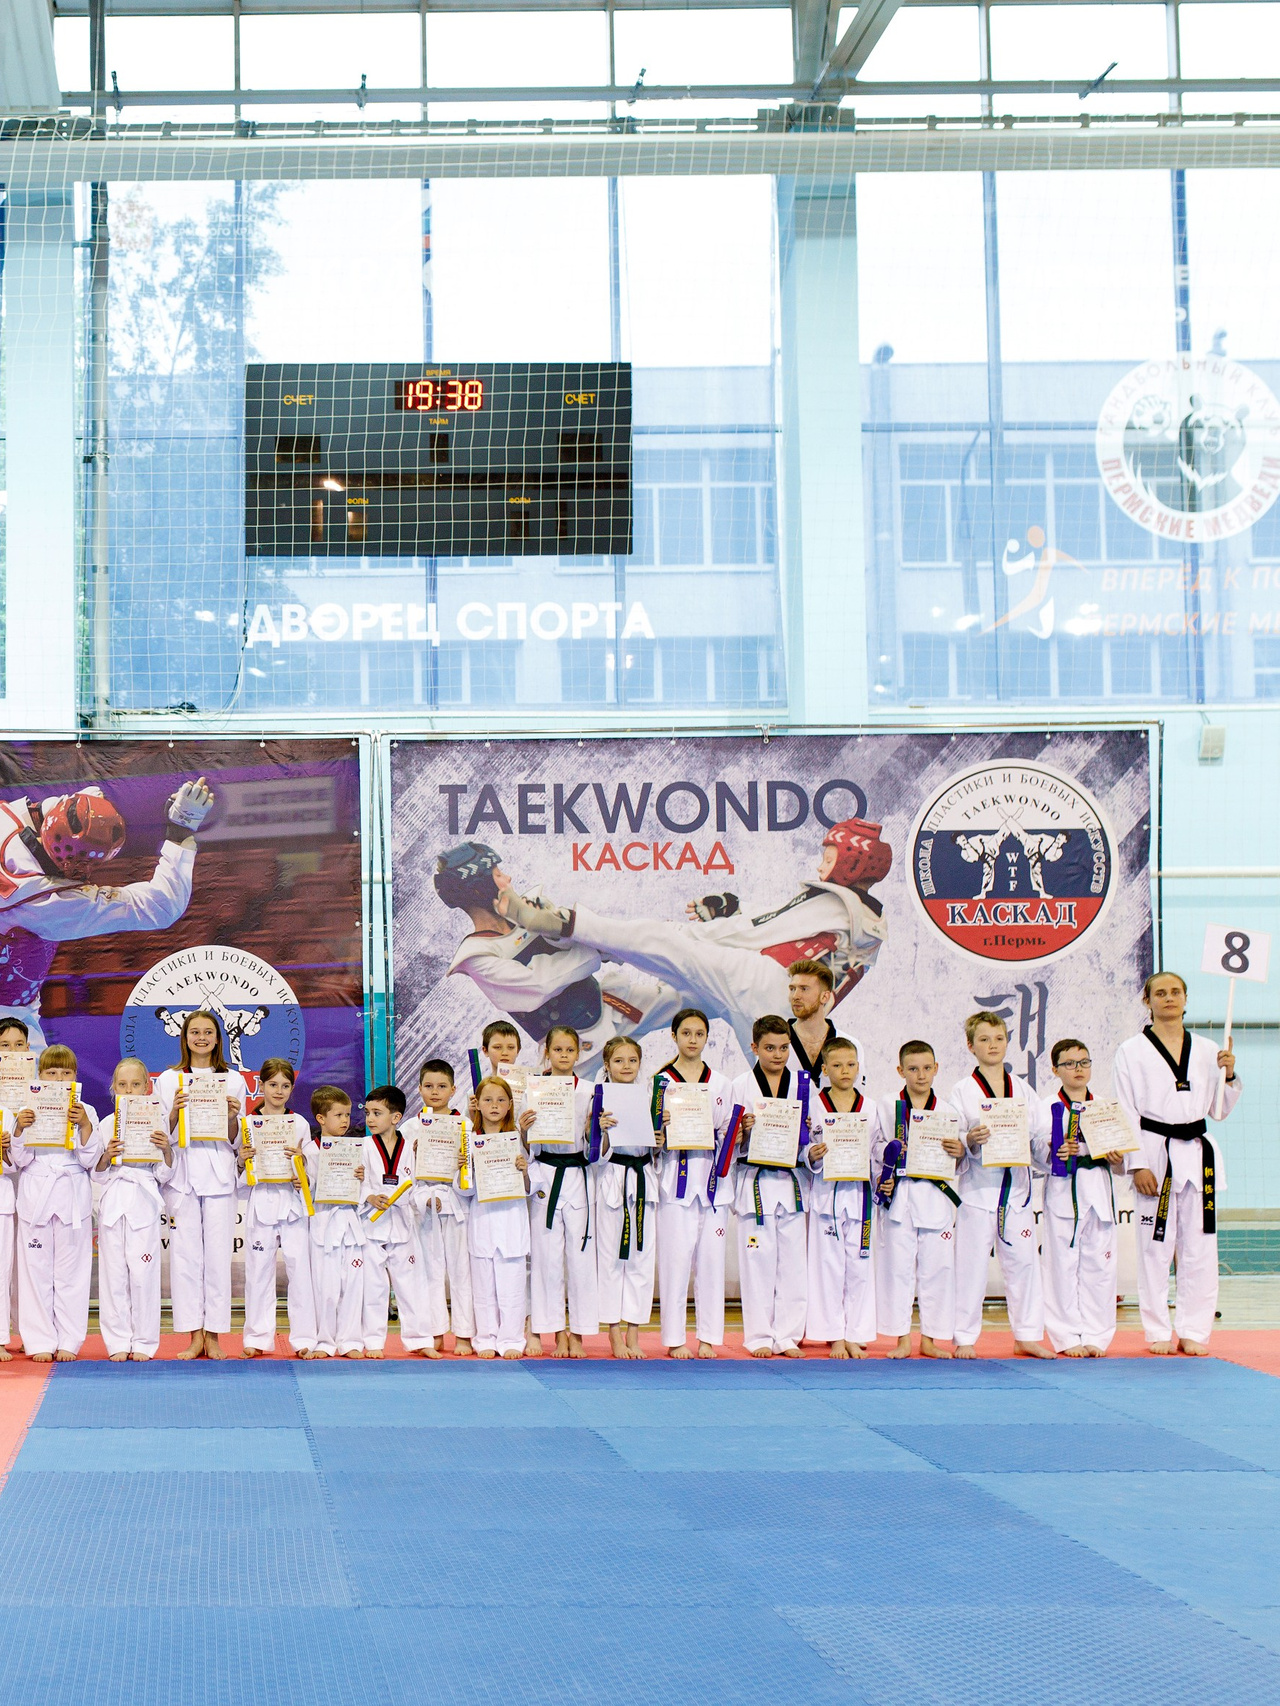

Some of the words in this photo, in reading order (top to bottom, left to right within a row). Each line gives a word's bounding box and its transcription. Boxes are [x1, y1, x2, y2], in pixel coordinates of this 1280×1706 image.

[426, 369, 451, 377] ВРЕМЯ
[283, 395, 314, 406] СЧЕТ
[407, 381, 483, 410] 19:38
[565, 393, 596, 405] СЧЕТ
[428, 417, 449, 425] ТАЙМ
[347, 497, 370, 505] ФОЛЫ
[508, 497, 531, 505] ФОЛЫ
[1101, 457, 1195, 539] ПЕРМСКИЕ
[246, 602, 440, 648] ДВОРЕЦ
[456, 602, 656, 640] СПОРТА
[439, 778, 868, 836] TAEKWONDO
[962, 794, 1061, 821] TAEKWONDO
[918, 838, 936, 896] ШКОЛА
[927, 775, 994, 834] ПЛАСТИКИ
[1002, 773, 1012, 783] И
[1021, 774, 1080, 809] БОЕВЫХ
[1079, 812, 1106, 893] ИСКУССТВ
[572, 841, 735, 875] КАСКАД
[946, 902, 1078, 929] КАСКАД
[983, 935, 1046, 948] г.Пермь
[1221, 931, 1250, 973] 8
[165, 971, 259, 997] TAEKWONDO
[125, 1015, 138, 1058] КОЛА
[132, 953, 197, 1007] ПЛАСТИКИ
[205, 951, 213, 960] И
[221, 951, 277, 986] БОЕВЫХ
[863, 1219, 871, 1247] RUSSIA
